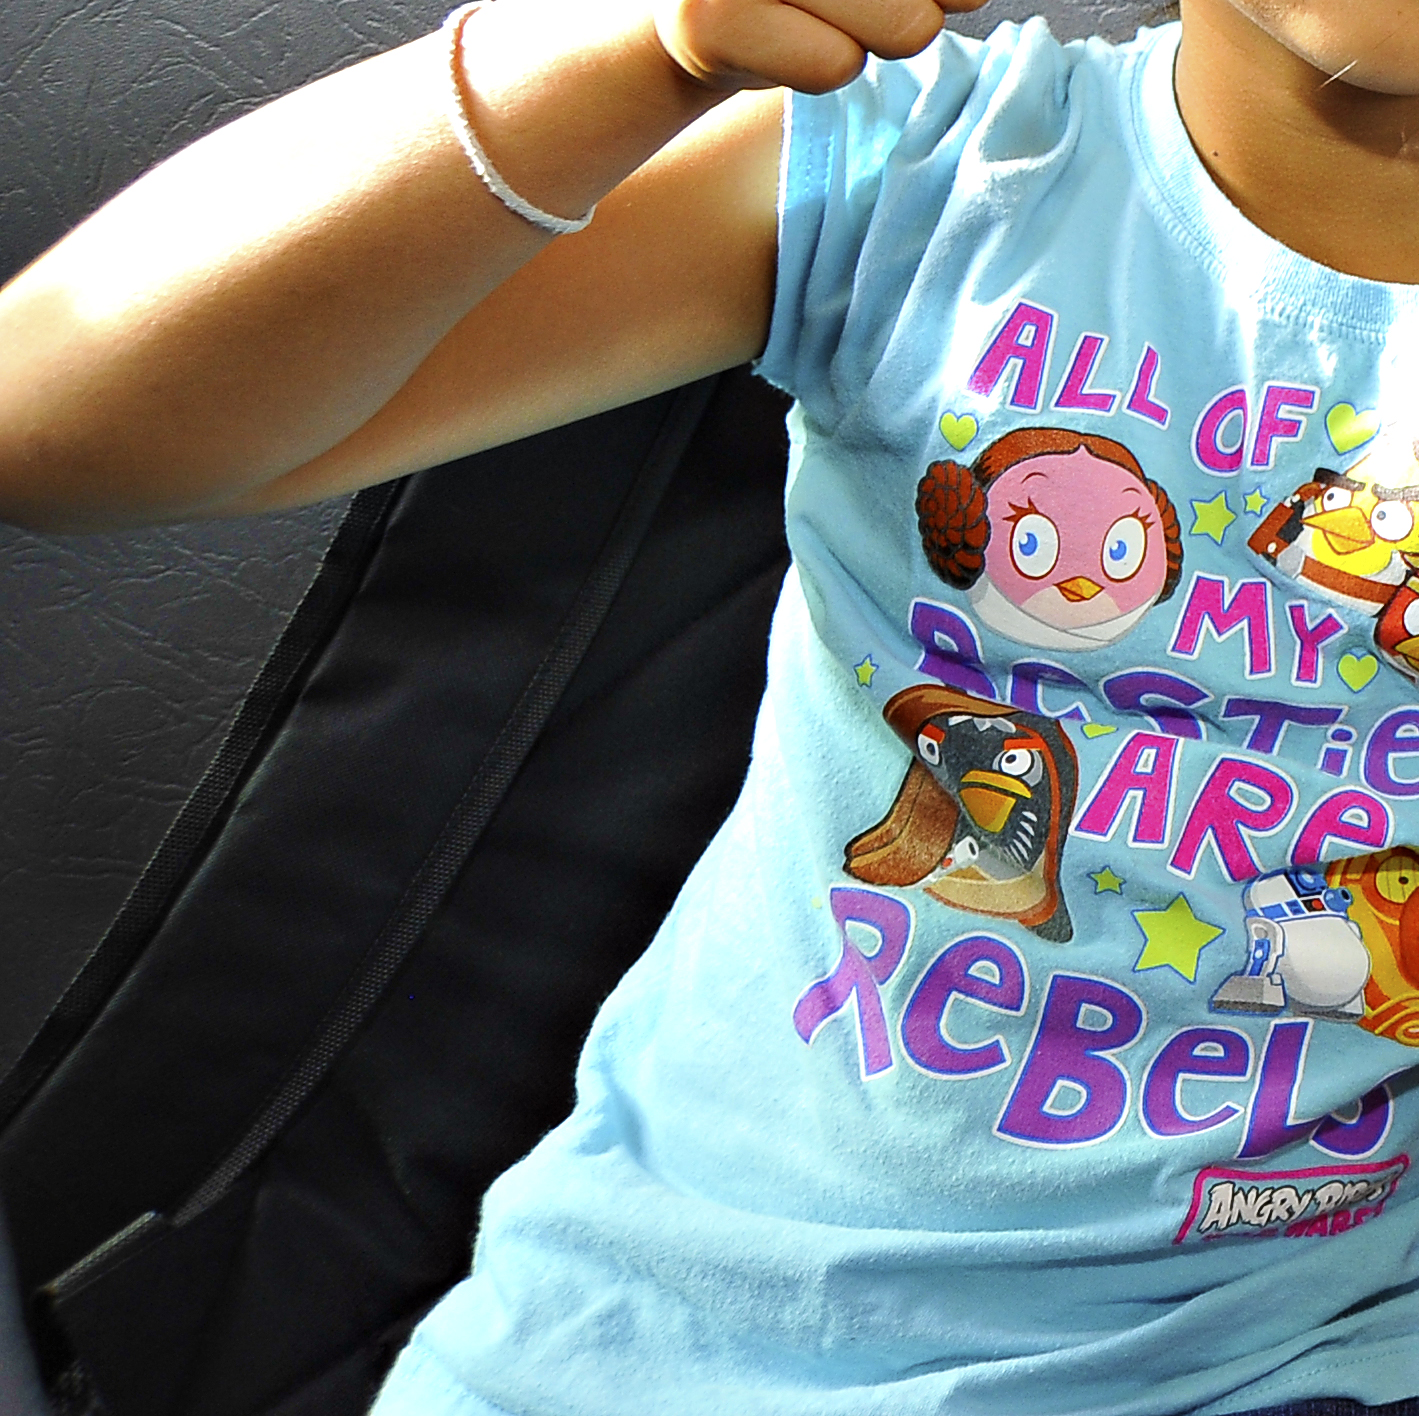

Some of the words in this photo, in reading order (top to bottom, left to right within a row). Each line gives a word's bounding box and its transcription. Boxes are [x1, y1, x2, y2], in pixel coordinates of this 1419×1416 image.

[964, 298, 1171, 430] ALL
[1191, 380, 1321, 477] OF
[1169, 571, 1346, 689] MY
[1198, 1180, 1313, 1233] ANGRY
